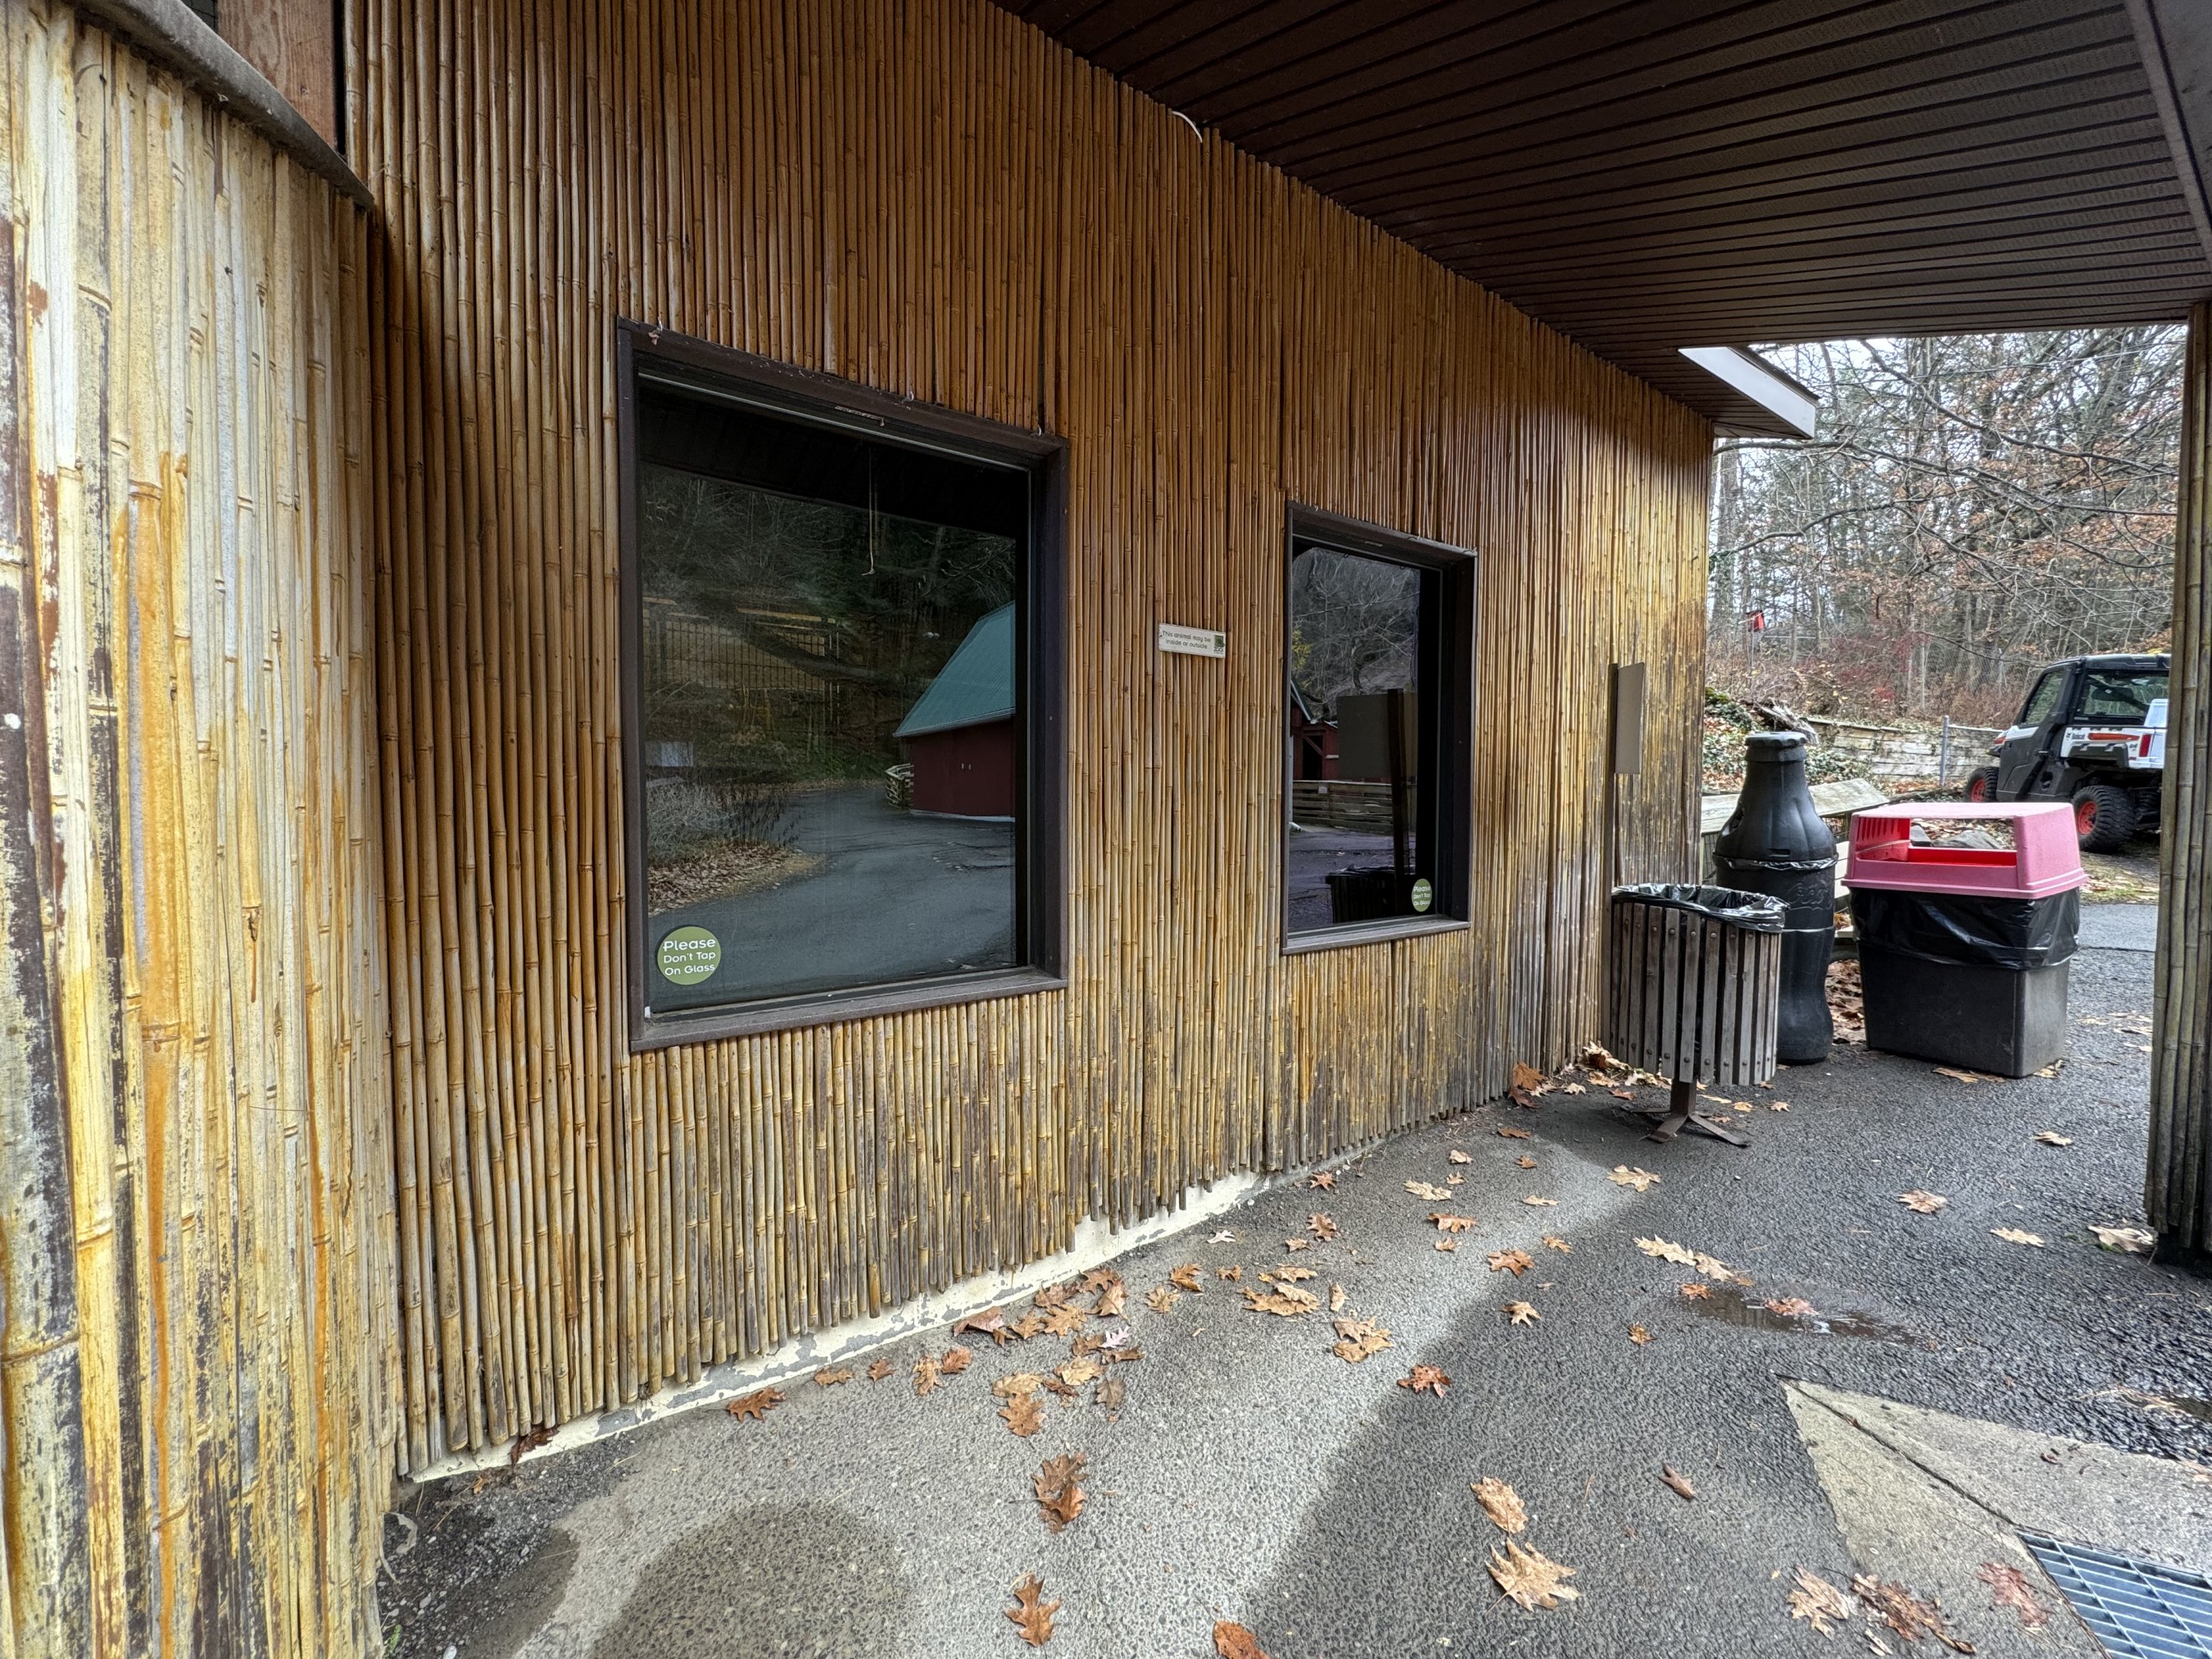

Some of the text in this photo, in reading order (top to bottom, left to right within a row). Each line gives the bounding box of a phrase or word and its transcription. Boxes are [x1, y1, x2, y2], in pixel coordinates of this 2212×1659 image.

[663, 939, 716, 952] Please
[664, 952, 716, 964] Don't Tap
[664, 964, 715, 975] On Glass
